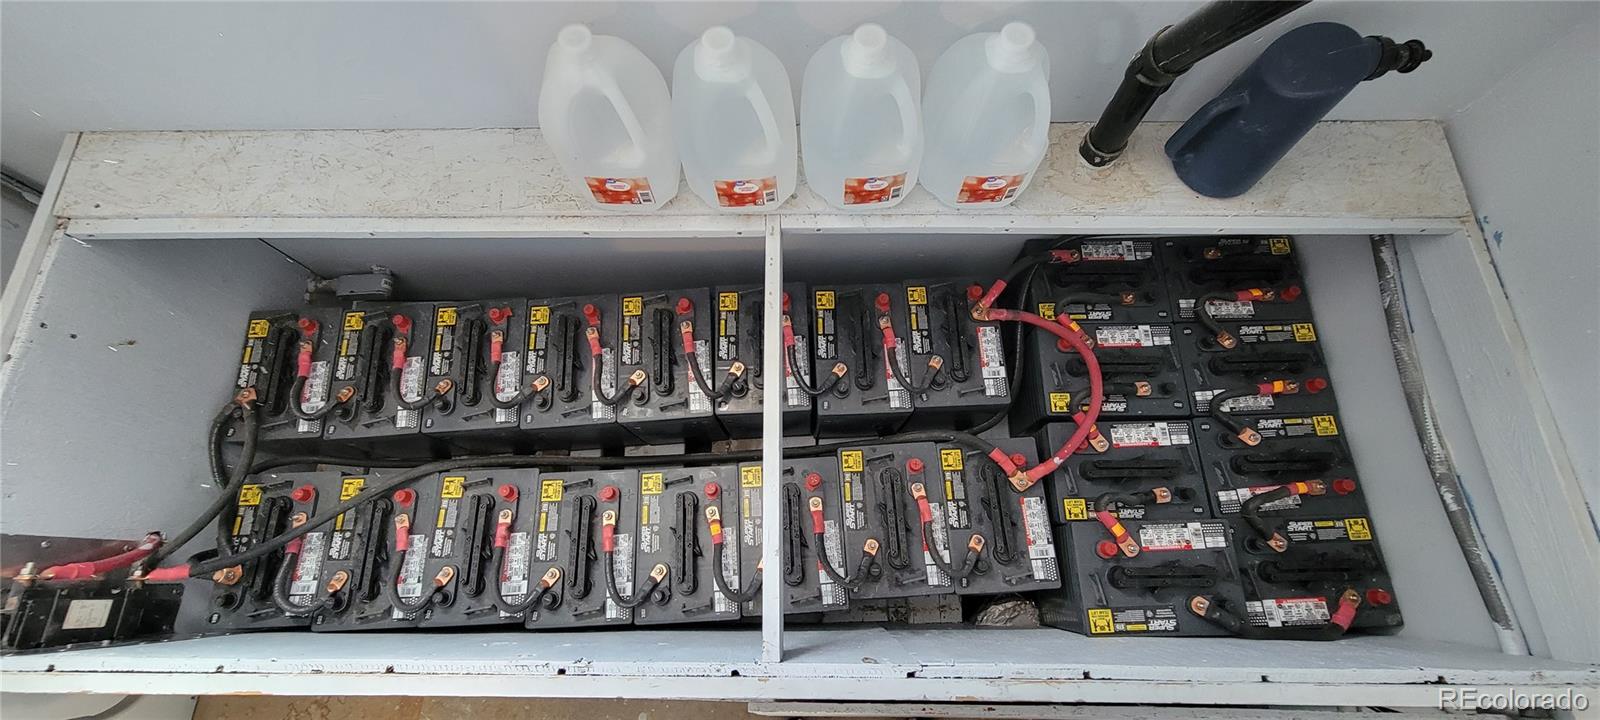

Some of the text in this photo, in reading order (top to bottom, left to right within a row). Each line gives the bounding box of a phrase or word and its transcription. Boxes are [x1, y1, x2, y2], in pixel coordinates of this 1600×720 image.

[329, 531, 337, 556] SUPER
[333, 531, 342, 559] START
[436, 529, 444, 556] START
